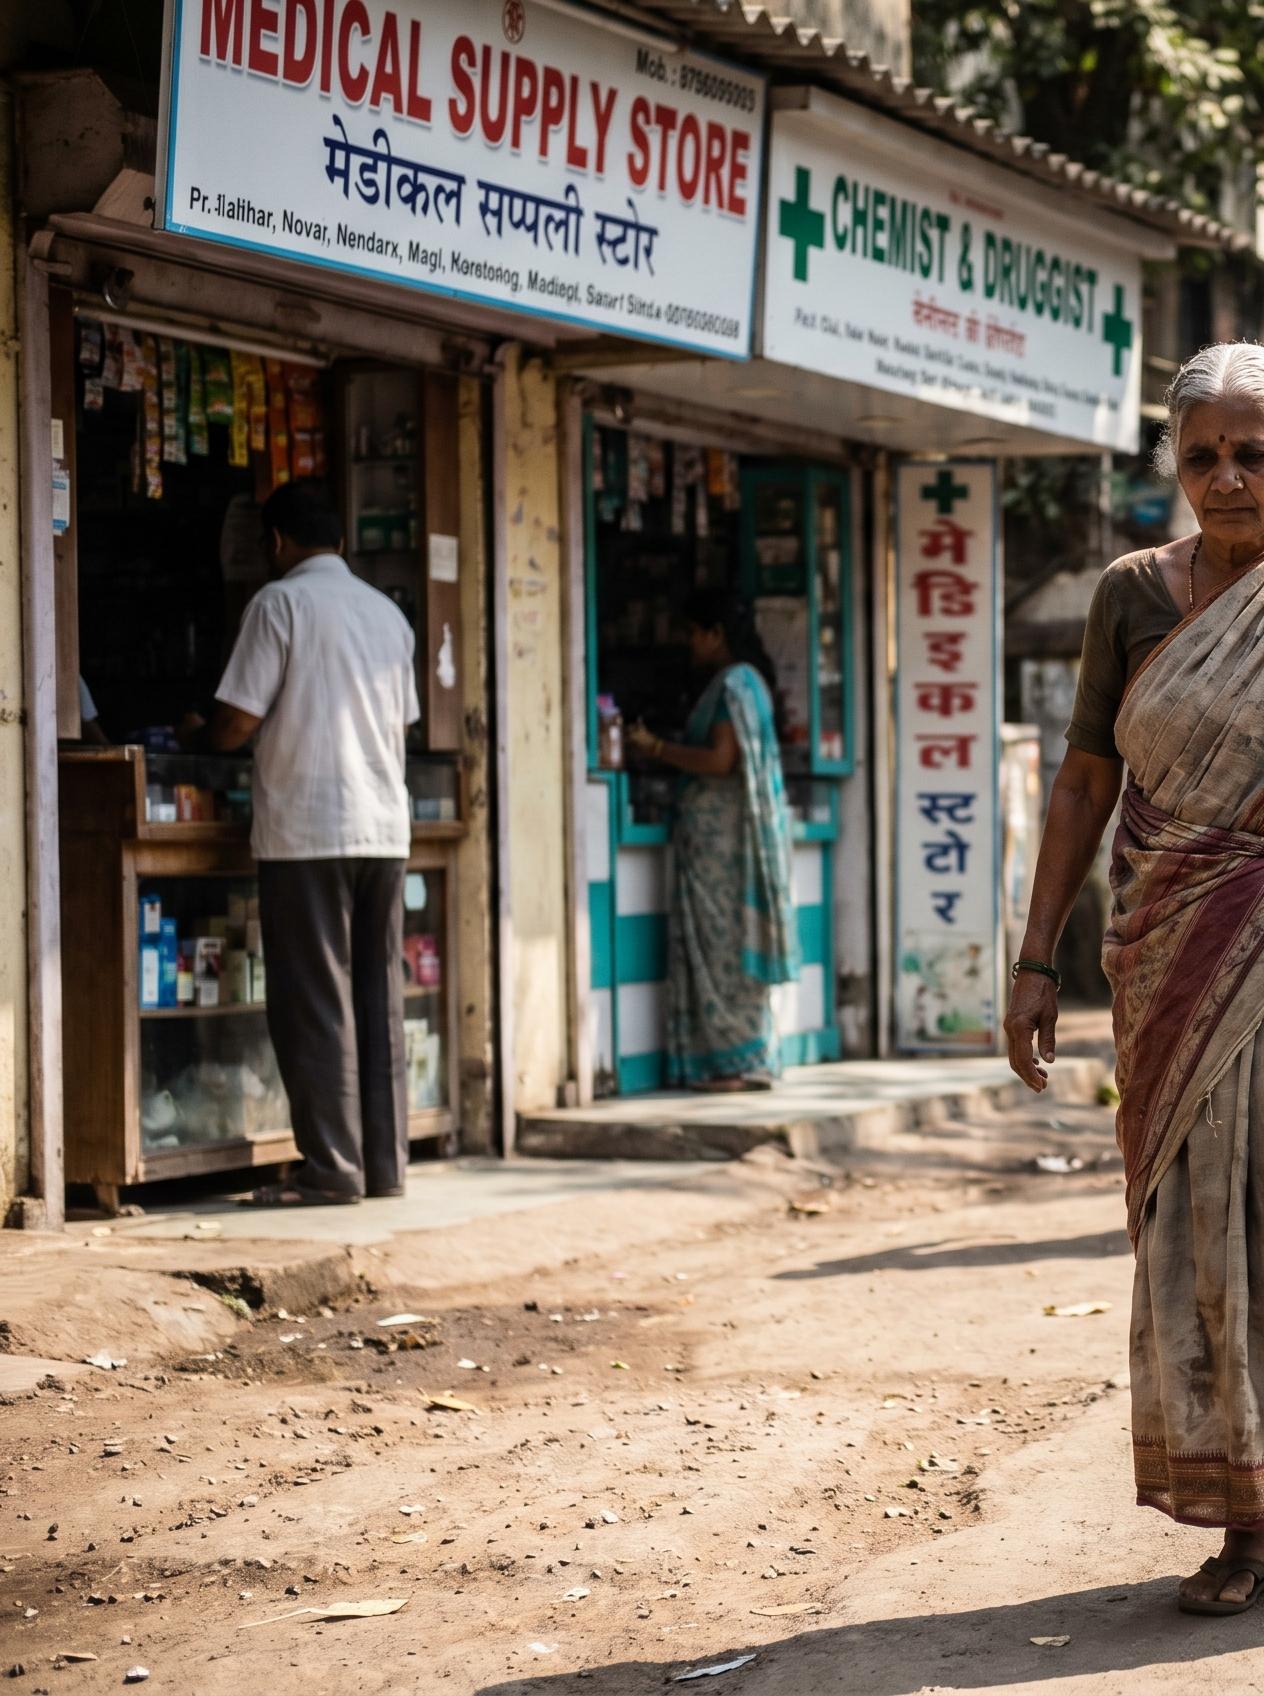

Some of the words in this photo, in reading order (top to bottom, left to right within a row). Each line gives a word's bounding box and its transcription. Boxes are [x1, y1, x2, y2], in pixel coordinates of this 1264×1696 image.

[200, 0, 432, 123] MEDICAL
[449, 34, 618, 178] SUPPLY
[627, 95, 751, 217] STORE
[323, 114, 466, 228] मेडीकल
[477, 183, 584, 257] सप्पली
[594, 198, 658, 276] स्टोर
[831, 174, 951, 284] CHEMIST
[957, 221, 975, 293] &
[983, 230, 1099, 335] DRUGGIST
